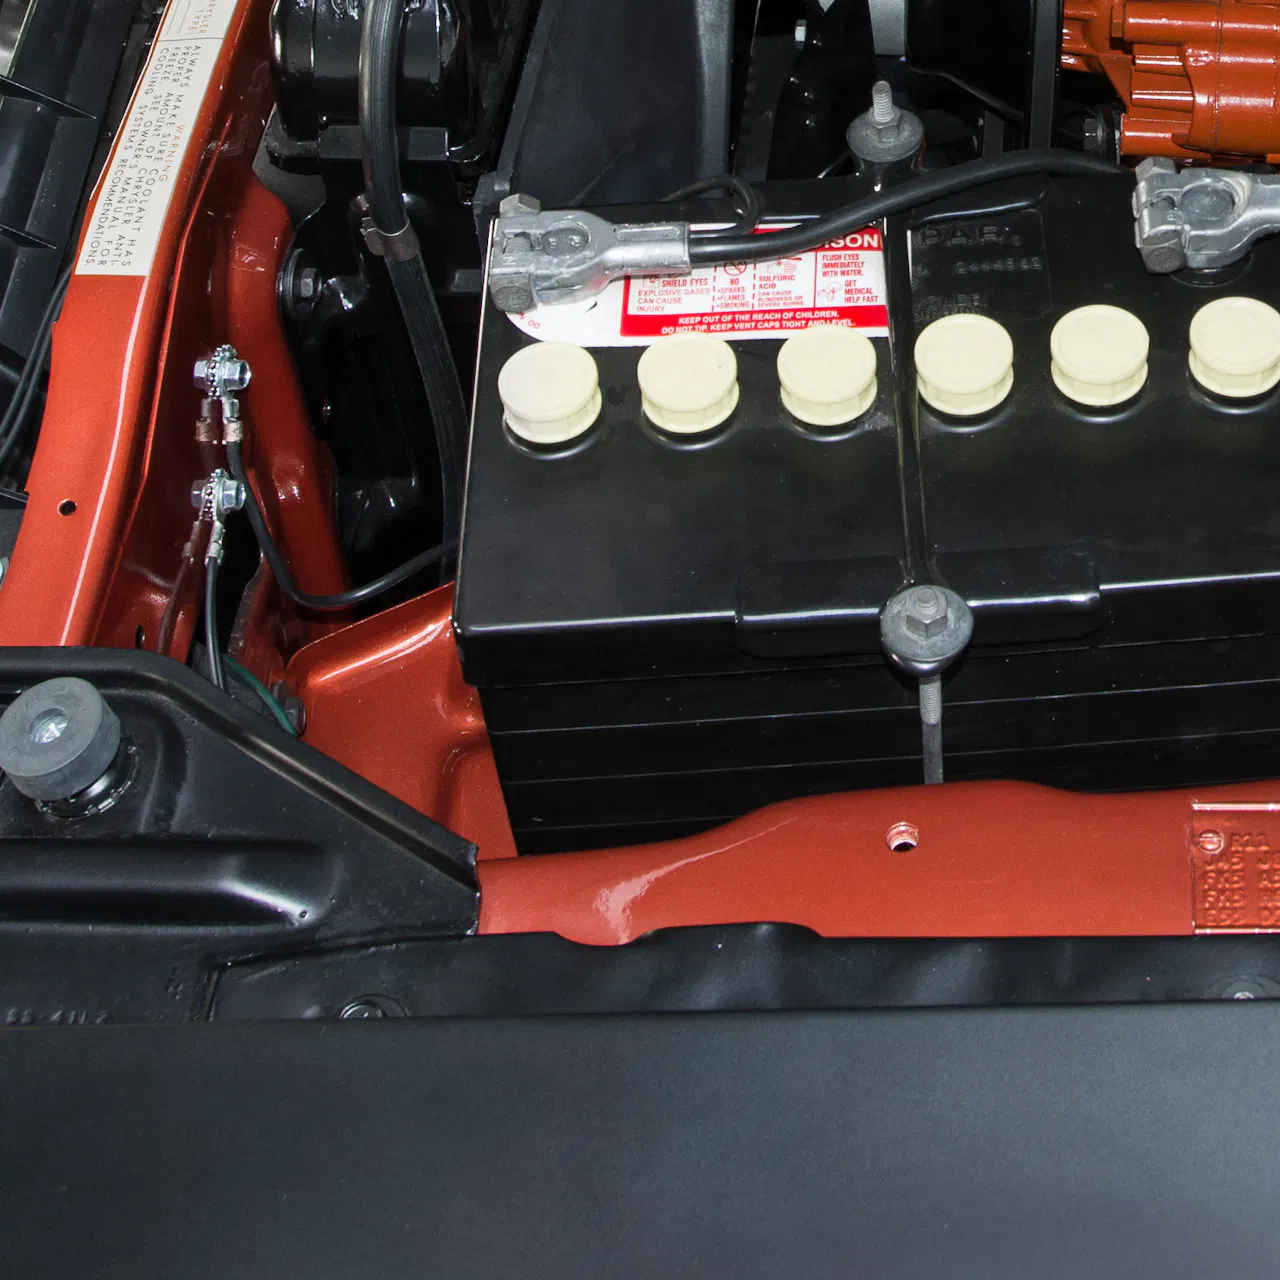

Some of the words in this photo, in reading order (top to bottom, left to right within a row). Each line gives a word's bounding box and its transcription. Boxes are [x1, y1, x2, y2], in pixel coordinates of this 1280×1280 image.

[143, 46, 170, 95] COOLING
[157, 46, 180, 84] FREEZE.
[169, 45, 192, 84] PROPER
[178, 44, 202, 88] ALWAYS
[148, 94, 163, 111] SEE
[164, 93, 185, 126] MAKE
[149, 91, 174, 137] AMOUNT
[122, 104, 148, 150] SYSTEMS
[127, 120, 154, 169] OWNER'S
[142, 144, 156, 161] OF
[152, 132, 171, 162] SURE
[156, 124, 186, 183] WARNING
[106, 176, 134, 230] MANUAL
[119, 167, 149, 225] CHRYSLER
[128, 167, 161, 232] COOLANT
[81, 158, 130, 266] RECOMMENDATIONS.
[95, 239, 114, 266] FOR
[106, 233, 128, 266] ANTI-
[119, 238, 139, 267] HAS
[821, 254, 842, 262] FLUSH
[842, 253, 860, 261] EYES
[821, 261, 865, 269] IMMEDIATELY
[821, 269, 839, 278] WITH
[839, 268, 864, 277] WATER.
[661, 279, 687, 288] SHIELD
[689, 278, 709, 287] EYES
[729, 278, 740, 286] NO
[758, 274, 796, 283] SULFURIC
[758, 282, 777, 290] ACID
[844, 280, 858, 288] GET
[637, 297, 655, 305] CAN
[656, 296, 683, 305] CAUSE
[638, 289, 682, 297] EXPLOSIVE
[683, 287, 711, 296] GASES
[844, 287, 873, 295] MEDICAL
[844, 295, 861, 303] HELP
[861, 295, 879, 303] FAST
[636, 305, 666, 313] INJURY
[678, 316, 701, 325] KEEP
[702, 315, 720, 323] OUT
[720, 314, 732, 323] OF
[734, 313, 750, 322] THE
[751, 312, 781, 321] REACH
[782, 312, 794, 320] OF
[795, 310, 840, 319] CHILDREN.
[661, 326, 675, 335] DO
[676, 325, 693, 334] NOT
[710, 323, 732, 332] KEEP
[734, 322, 756, 331] VENT
[757, 321, 781, 330] CAPS
[782, 321, 806, 329] TIGHT
